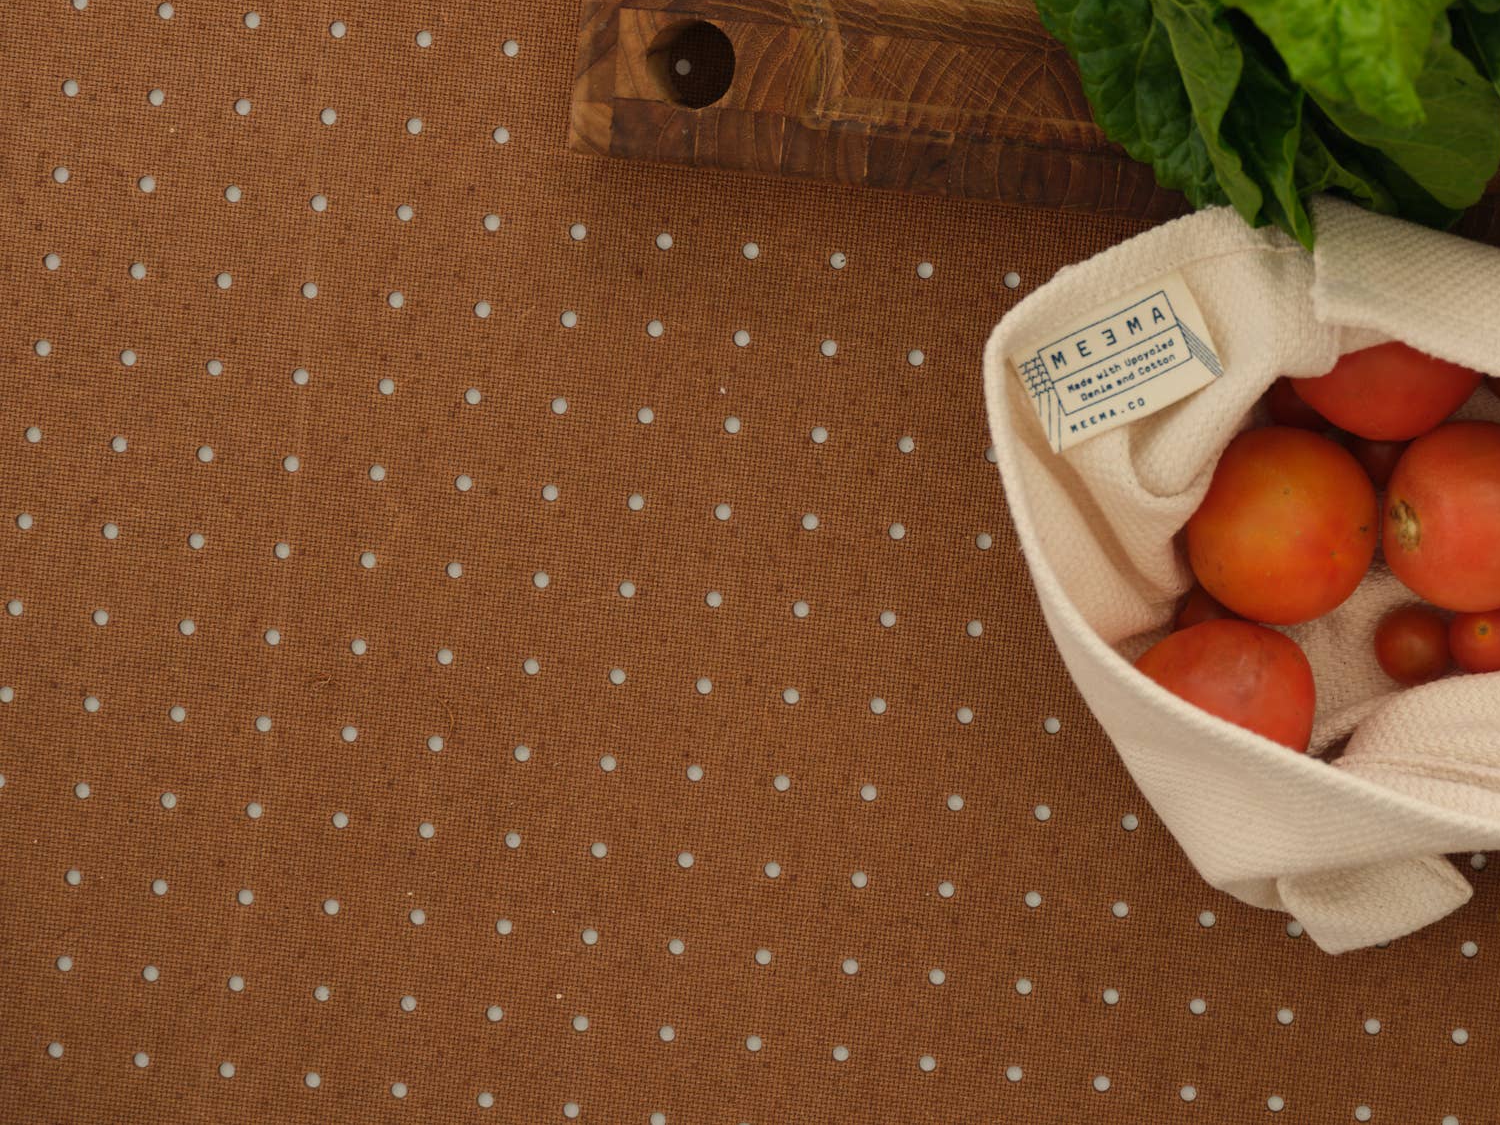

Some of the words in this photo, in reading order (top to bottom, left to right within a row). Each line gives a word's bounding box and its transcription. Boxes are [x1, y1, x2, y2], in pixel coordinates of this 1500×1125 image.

[1067, 378, 1093, 393] Made
[1097, 364, 1122, 380] with
[1124, 339, 1175, 367] Upcycled
[1081, 384, 1113, 401] Denim
[1116, 371, 1136, 386] and
[1138, 354, 1176, 375] Cotton
[1070, 397, 1146, 433] MEEMA.CO
